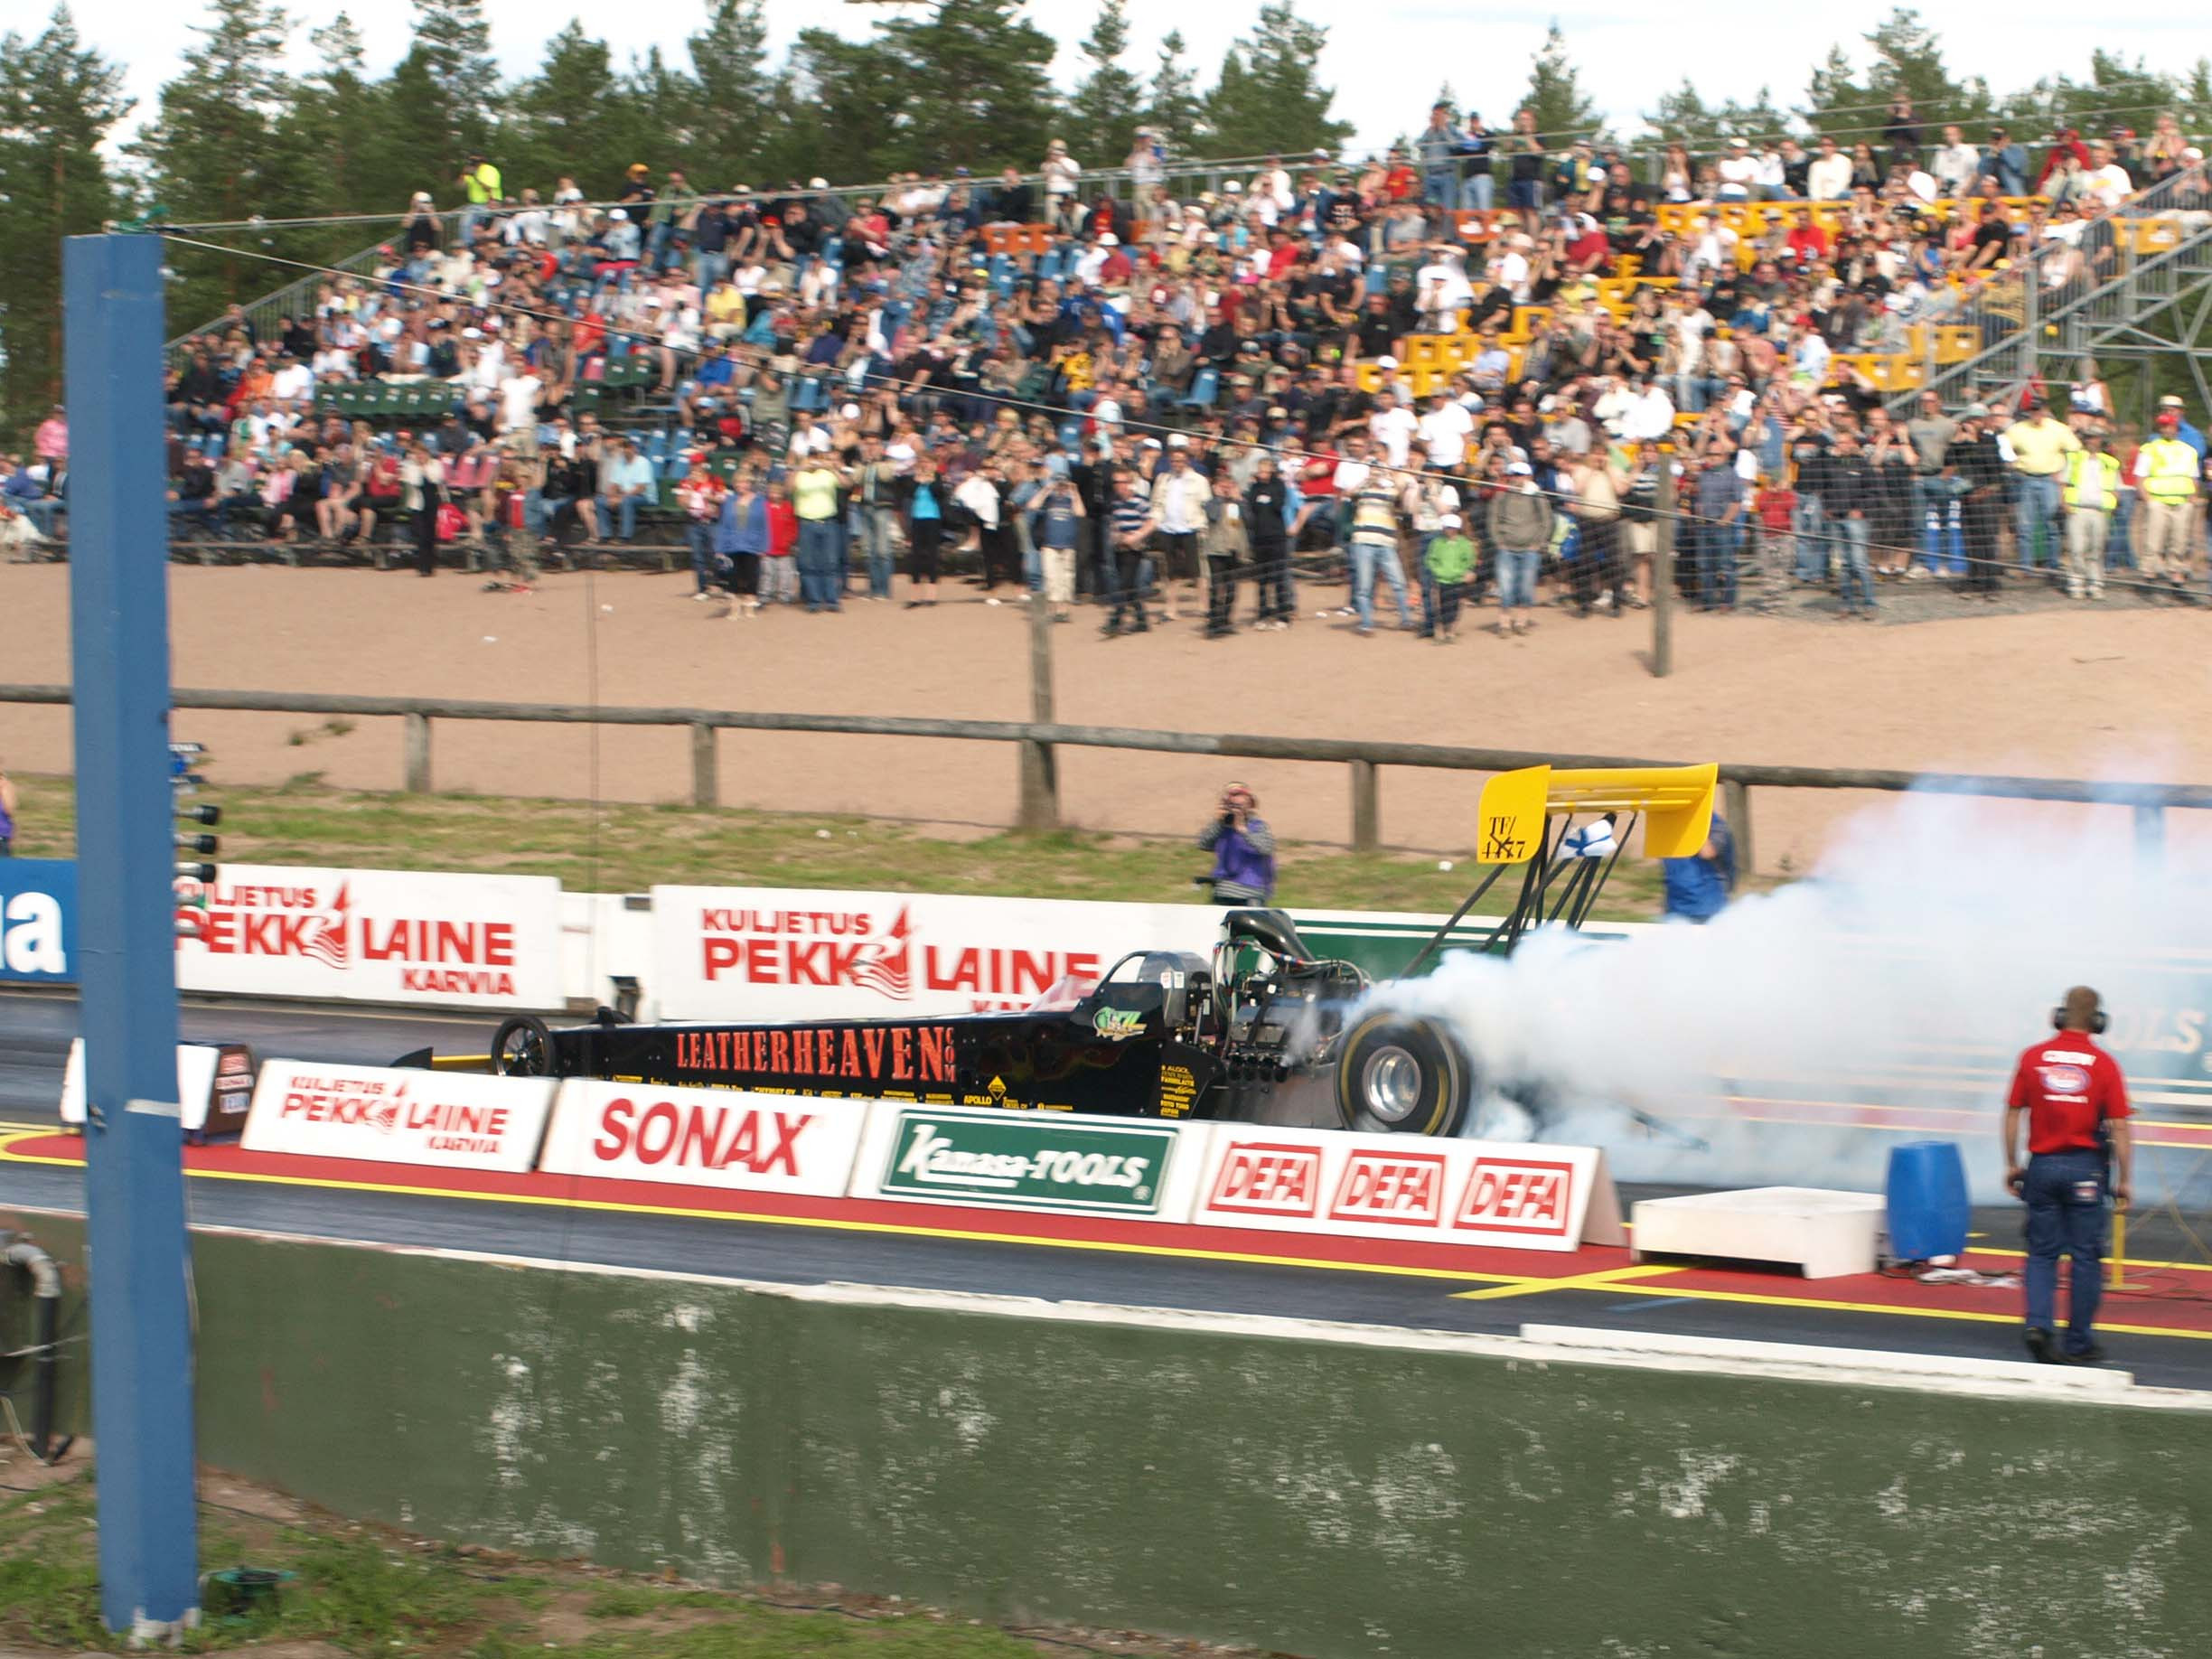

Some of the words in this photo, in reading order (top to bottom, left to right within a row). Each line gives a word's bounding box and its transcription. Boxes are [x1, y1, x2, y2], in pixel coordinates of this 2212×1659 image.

[362, 916, 515, 967] LAINE
[701, 908, 870, 935] KULJETUS
[400, 968, 518, 996] KARVIA
[923, 943, 1101, 996] LAINE
[676, 1026, 944, 1083] LEATHERHEAVEN
[405, 1101, 512, 1136] LAINE
[963, 1094, 993, 1107] APOLLO
[593, 1097, 817, 1176] SONAX
[1223, 1155, 1308, 1203] DEFA
[1344, 1162, 1434, 1212] DEFA
[1469, 1171, 1561, 1221] DEFA
